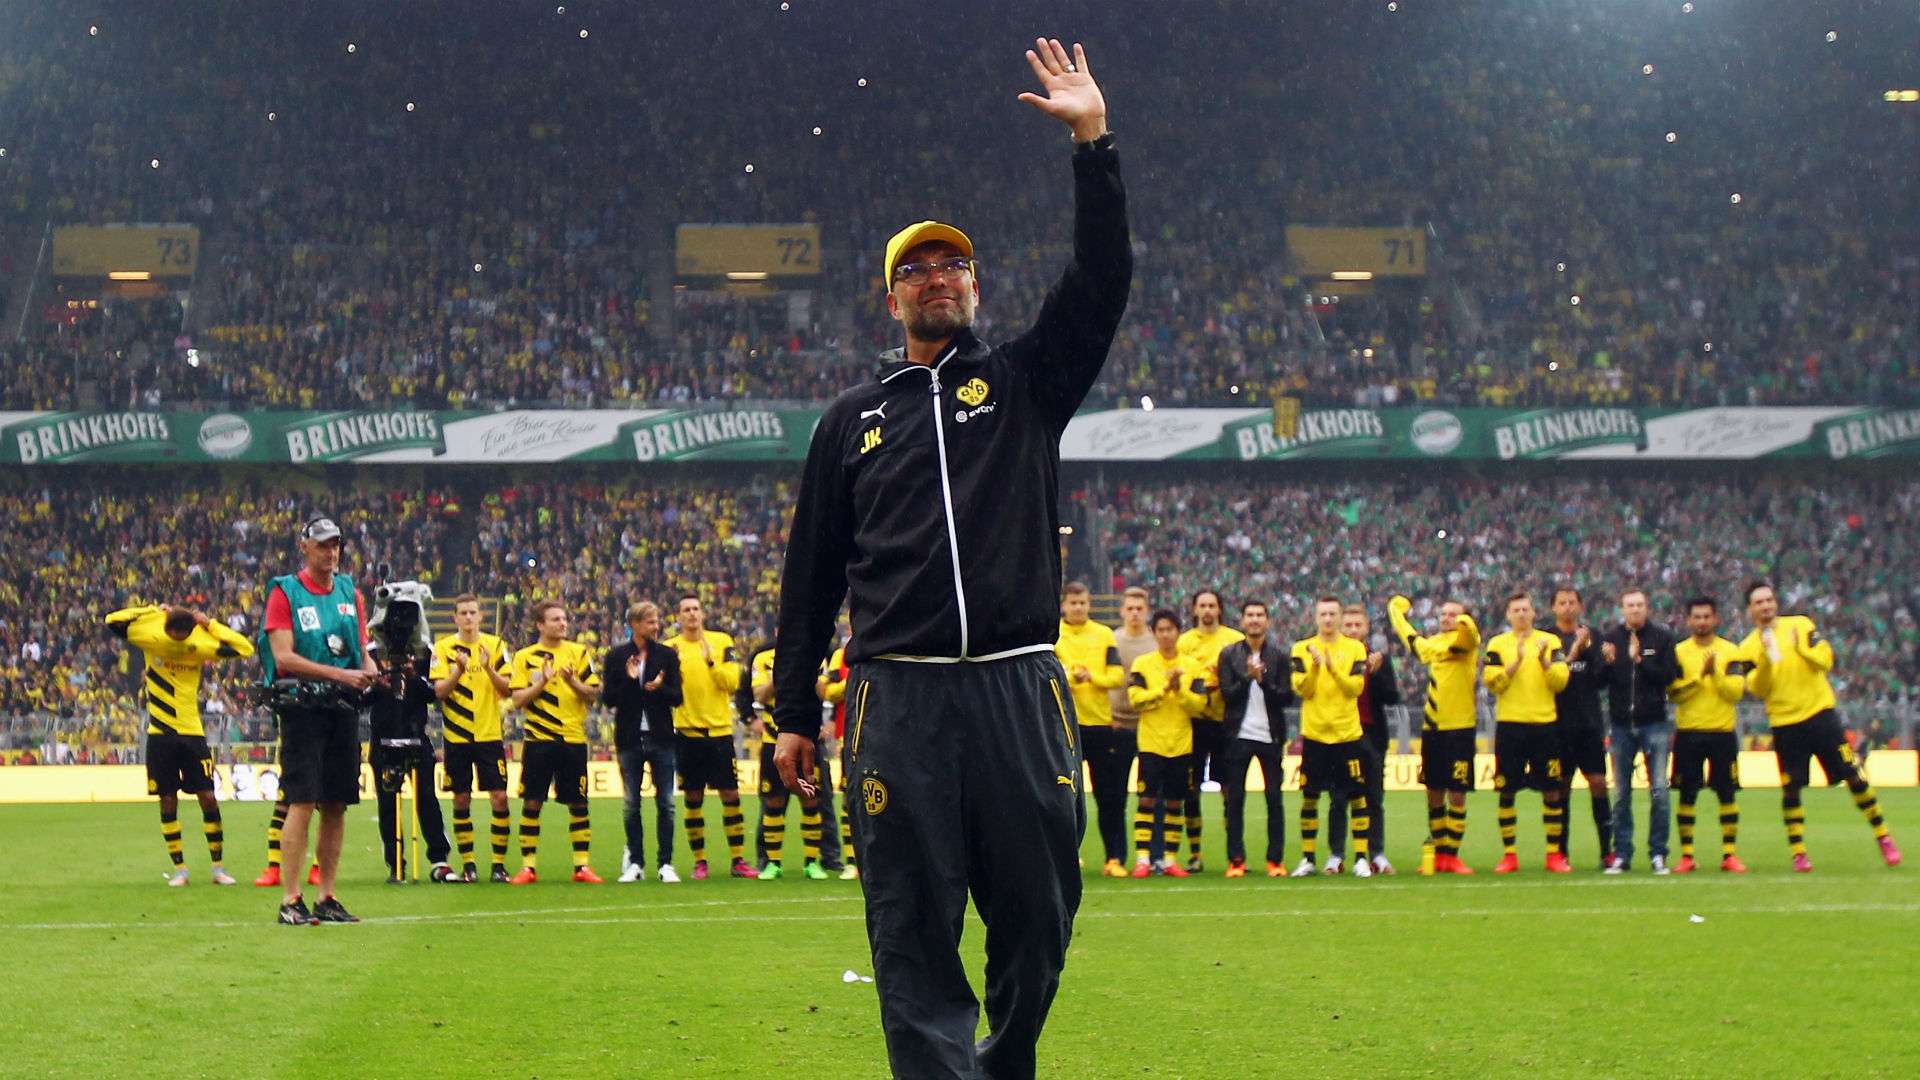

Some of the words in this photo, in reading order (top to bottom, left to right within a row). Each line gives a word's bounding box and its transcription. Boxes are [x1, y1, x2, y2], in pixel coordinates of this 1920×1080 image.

[157, 237, 192, 265] 73
[777, 237, 811, 265] 72
[1384, 239, 1416, 265] 71
[860, 426, 883, 454] JK
